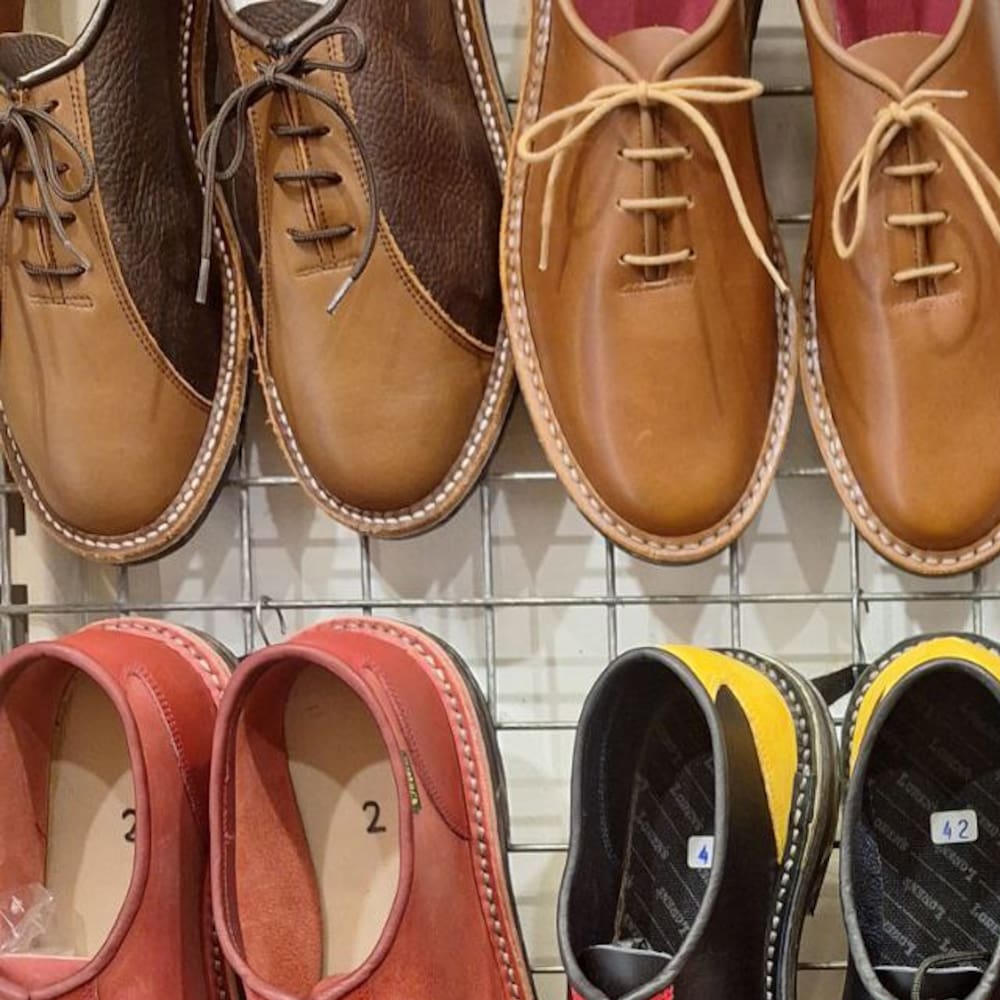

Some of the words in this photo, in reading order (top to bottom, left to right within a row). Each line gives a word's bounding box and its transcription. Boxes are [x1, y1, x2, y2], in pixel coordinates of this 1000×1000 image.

[122, 808, 136, 842] 2
[362, 800, 388, 834] 2
[943, 819, 969, 840] 42
